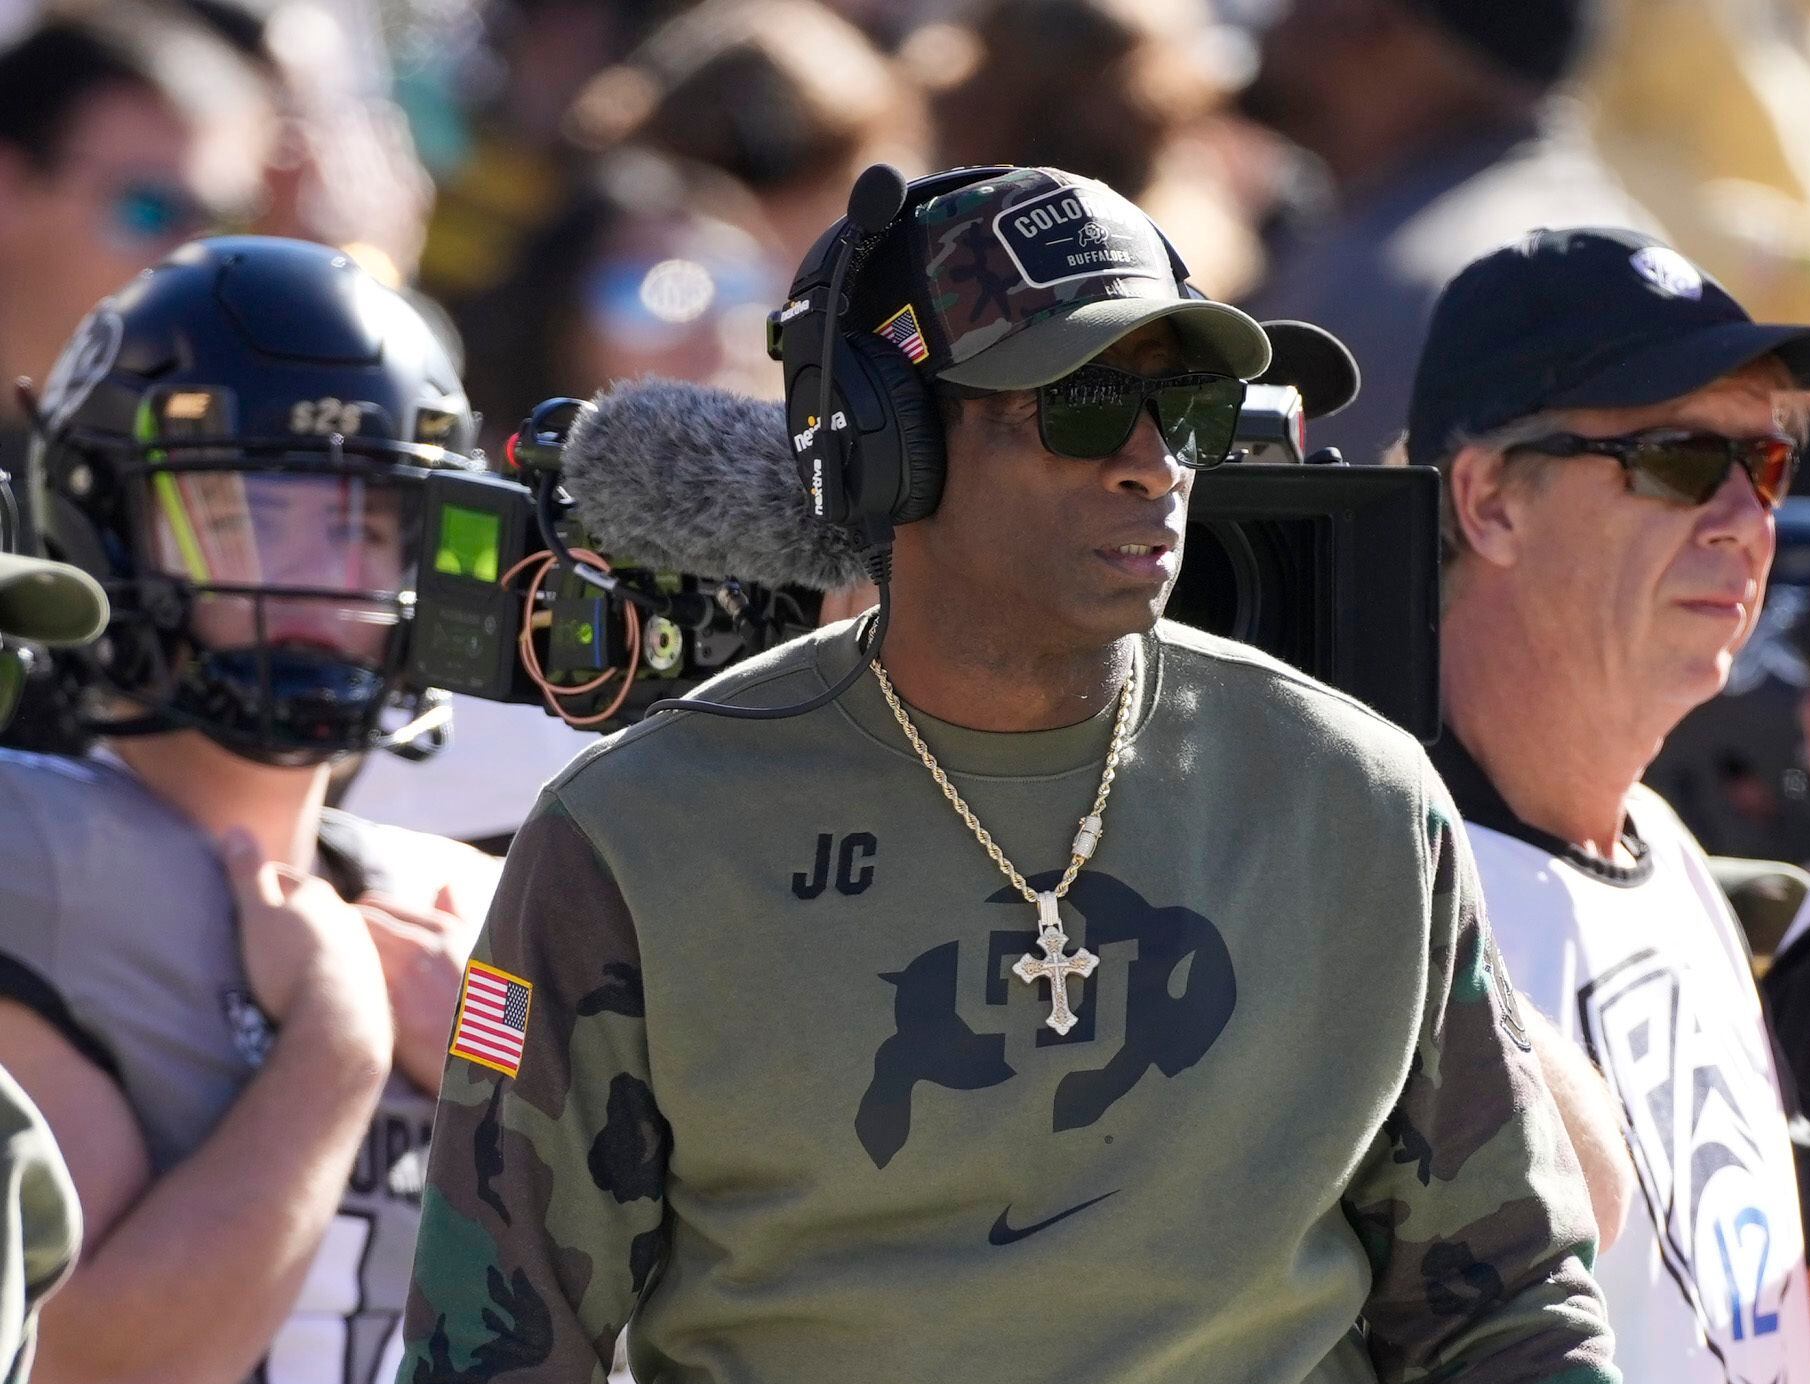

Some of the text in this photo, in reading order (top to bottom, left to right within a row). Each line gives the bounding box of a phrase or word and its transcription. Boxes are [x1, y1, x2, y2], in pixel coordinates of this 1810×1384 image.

[1066, 250, 1130, 267] BUFFALOES
[791, 831, 878, 900] JC
[1713, 1207, 1779, 1341] 12
